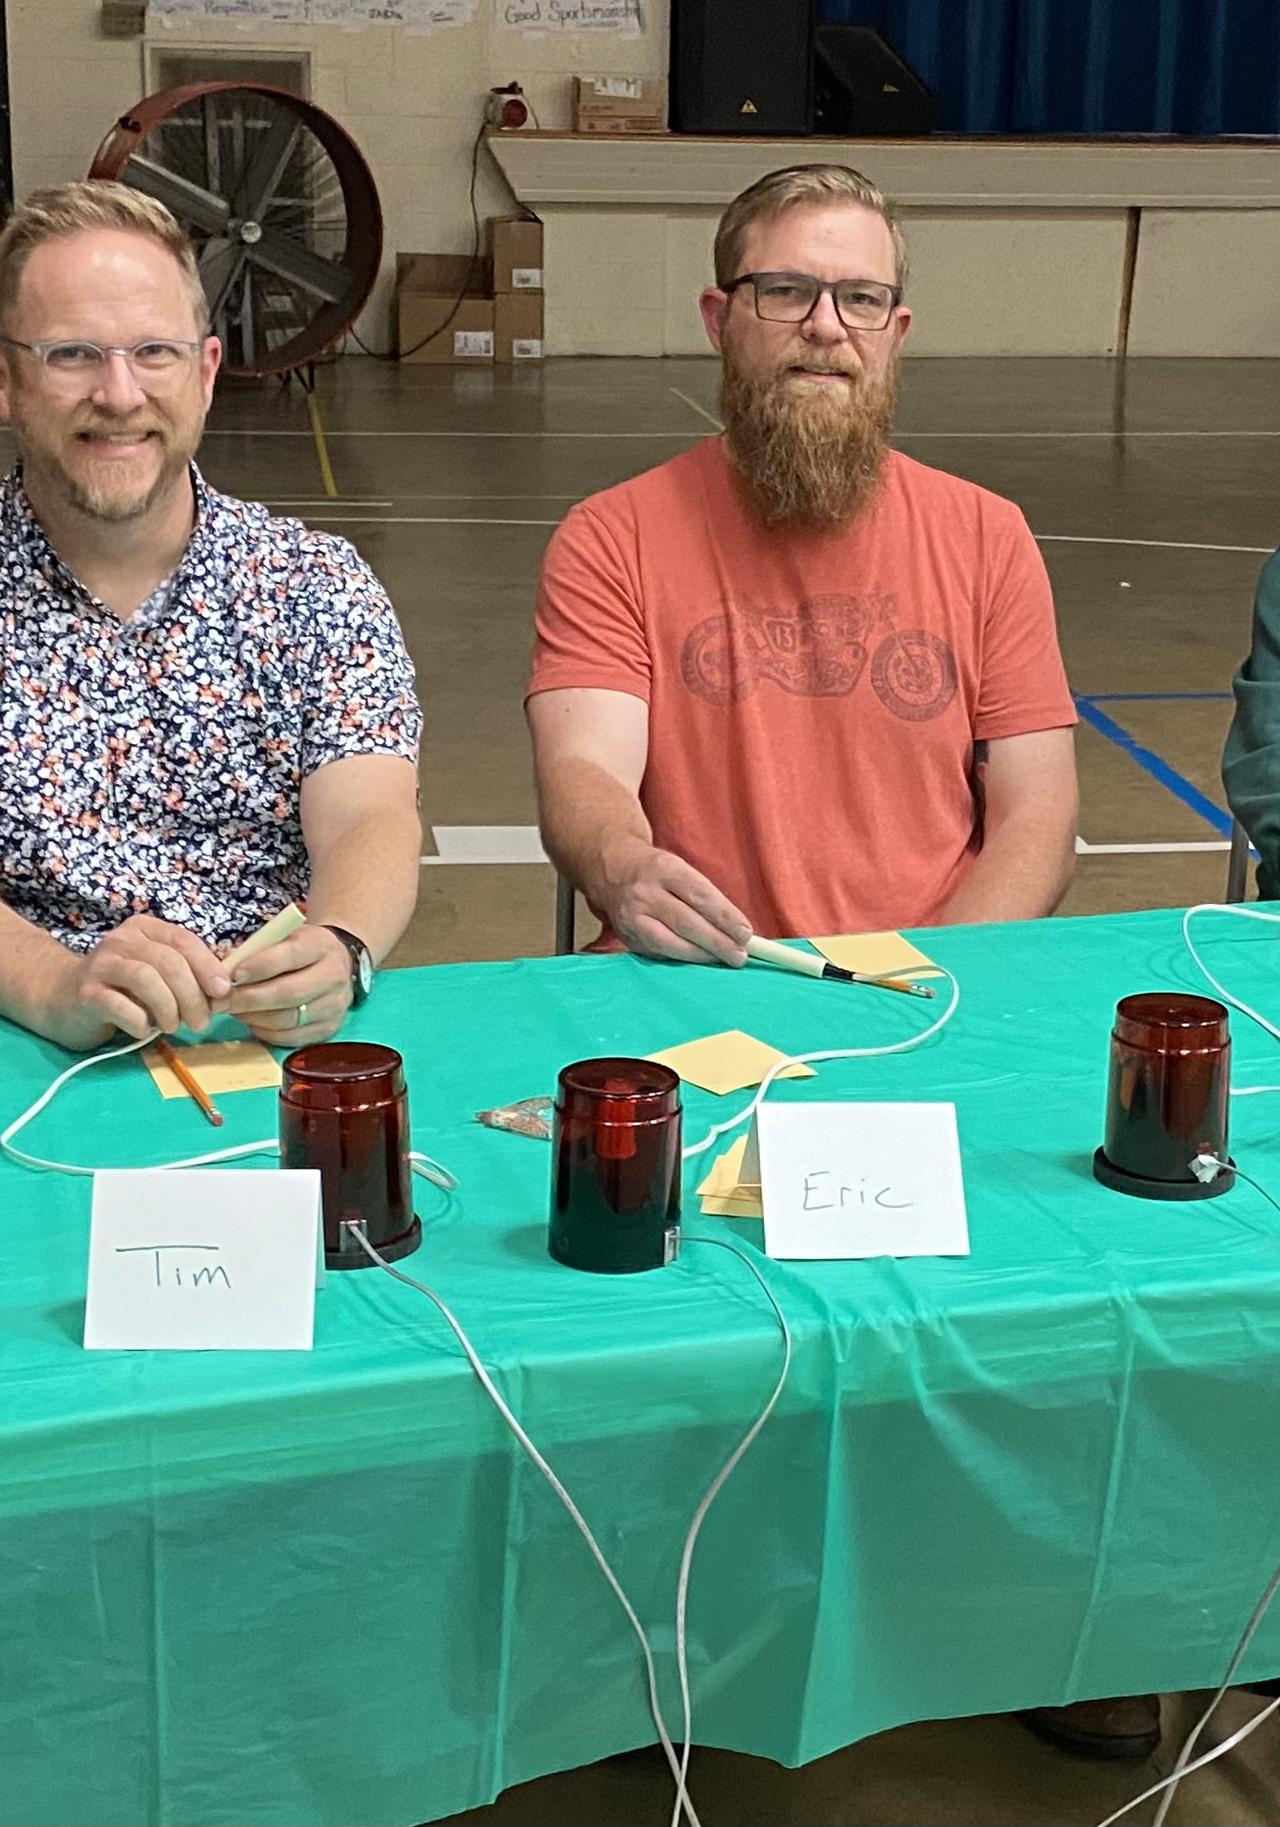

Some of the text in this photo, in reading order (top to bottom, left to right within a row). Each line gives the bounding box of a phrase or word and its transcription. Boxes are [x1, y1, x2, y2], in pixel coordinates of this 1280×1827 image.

[504, 2, 541, 24] Good
[774, 625, 794, 648] 13
[802, 1171, 914, 1211] Eric
[115, 1244, 232, 1289] Tim
